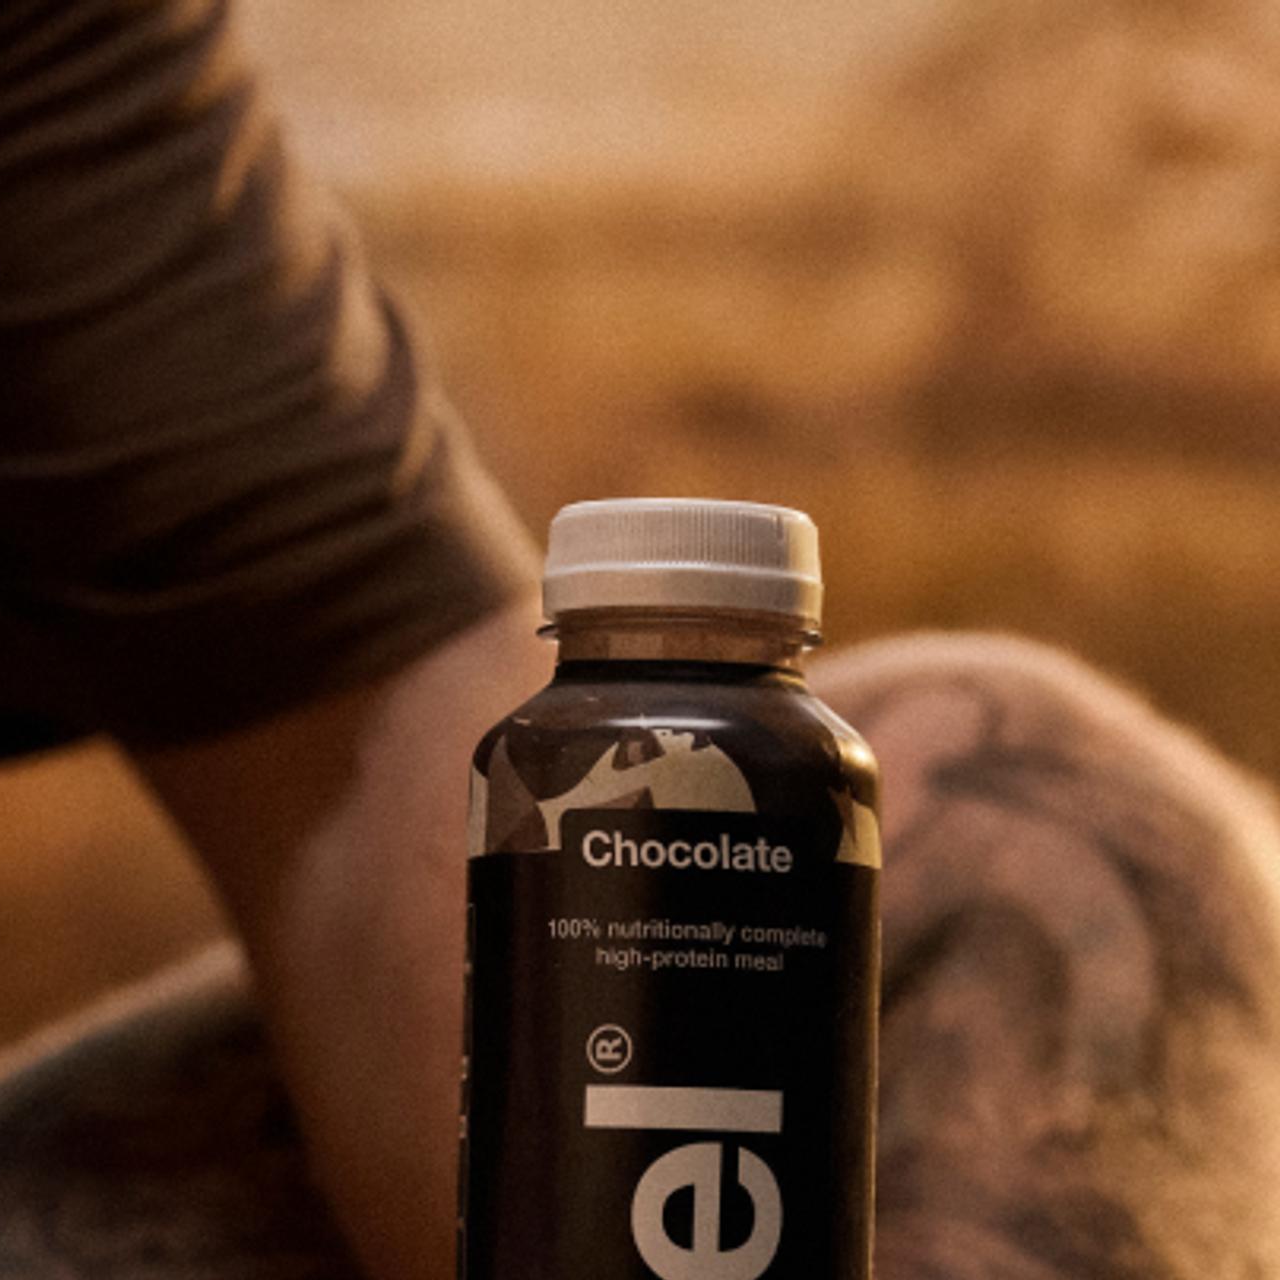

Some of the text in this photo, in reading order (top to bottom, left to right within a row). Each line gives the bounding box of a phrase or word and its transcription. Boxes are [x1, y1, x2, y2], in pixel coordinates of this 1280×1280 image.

[581, 830, 793, 872] Chocolate
[548, 919, 827, 948] 100% nutritionally complete
[595, 949, 784, 972] high-protein meal
